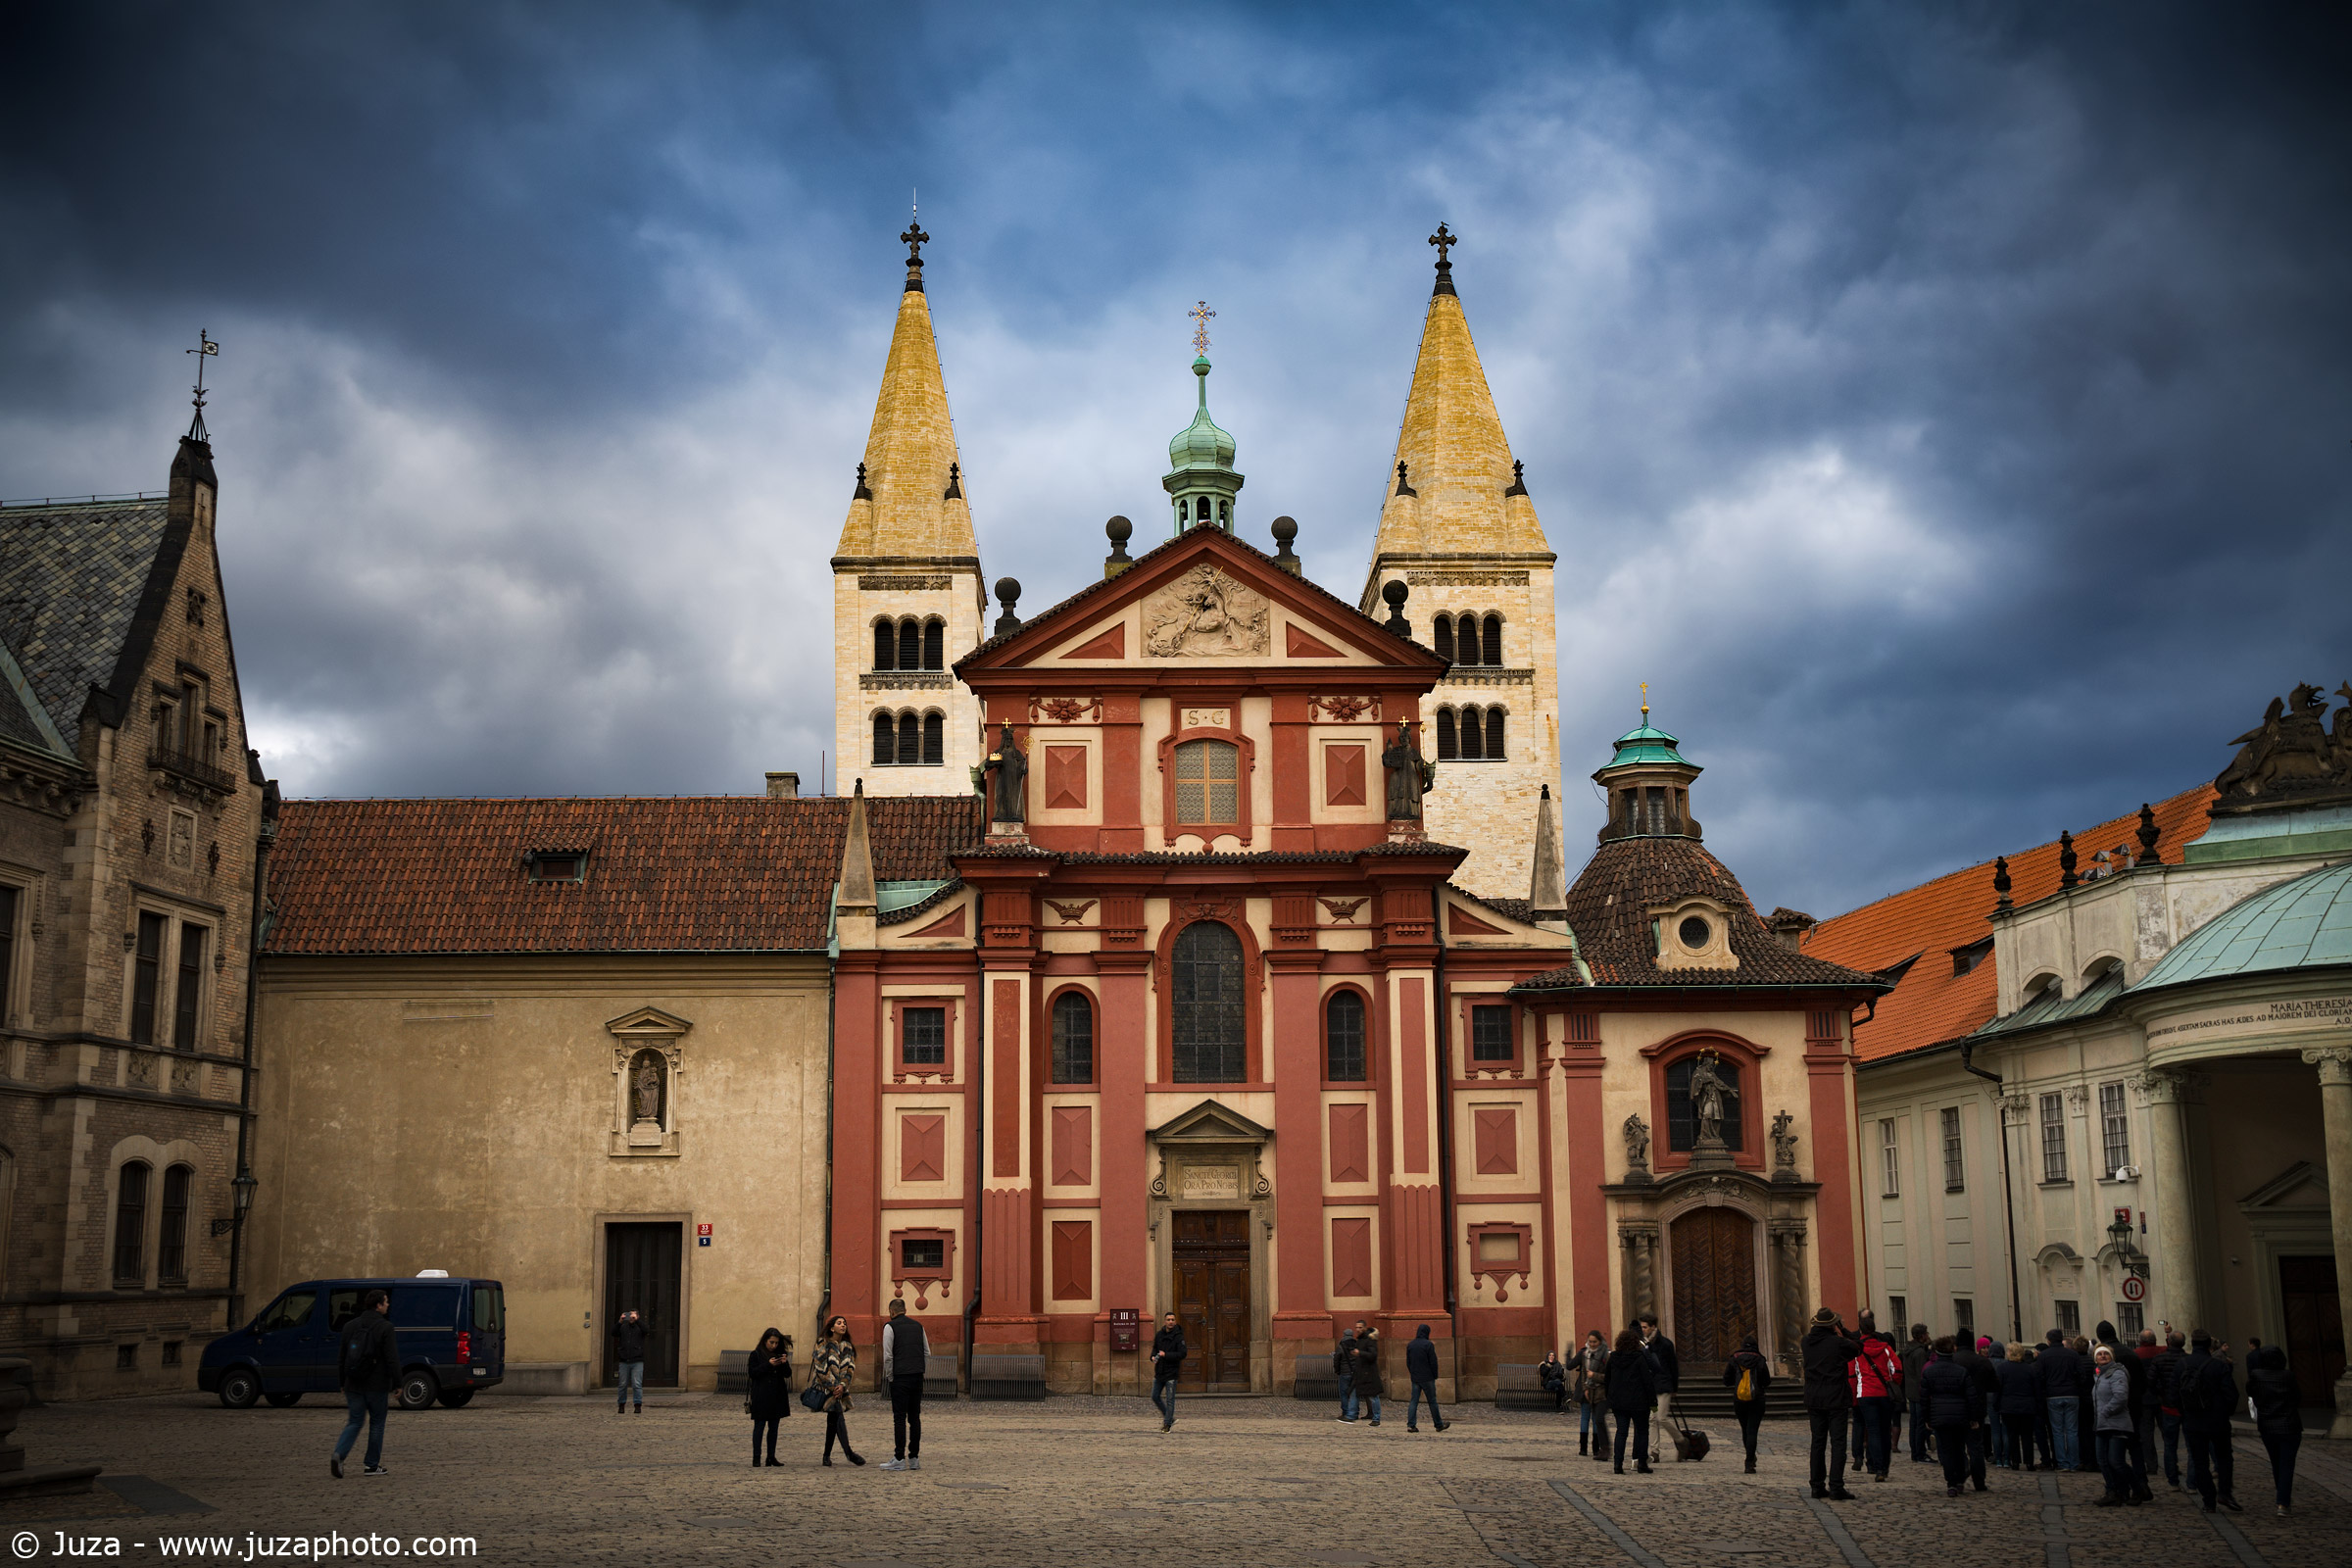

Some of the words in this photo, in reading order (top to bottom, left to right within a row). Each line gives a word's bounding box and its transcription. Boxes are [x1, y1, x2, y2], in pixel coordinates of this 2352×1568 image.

[1188, 710, 1200, 726] S
[1211, 710, 1224, 725] G
[2270, 1000, 2303, 1013] MARIA
[2221, 1017, 2234, 1026] HAS
[2256, 1013, 2267, 1022] AD
[2304, 1009, 2317, 1018] DEI
